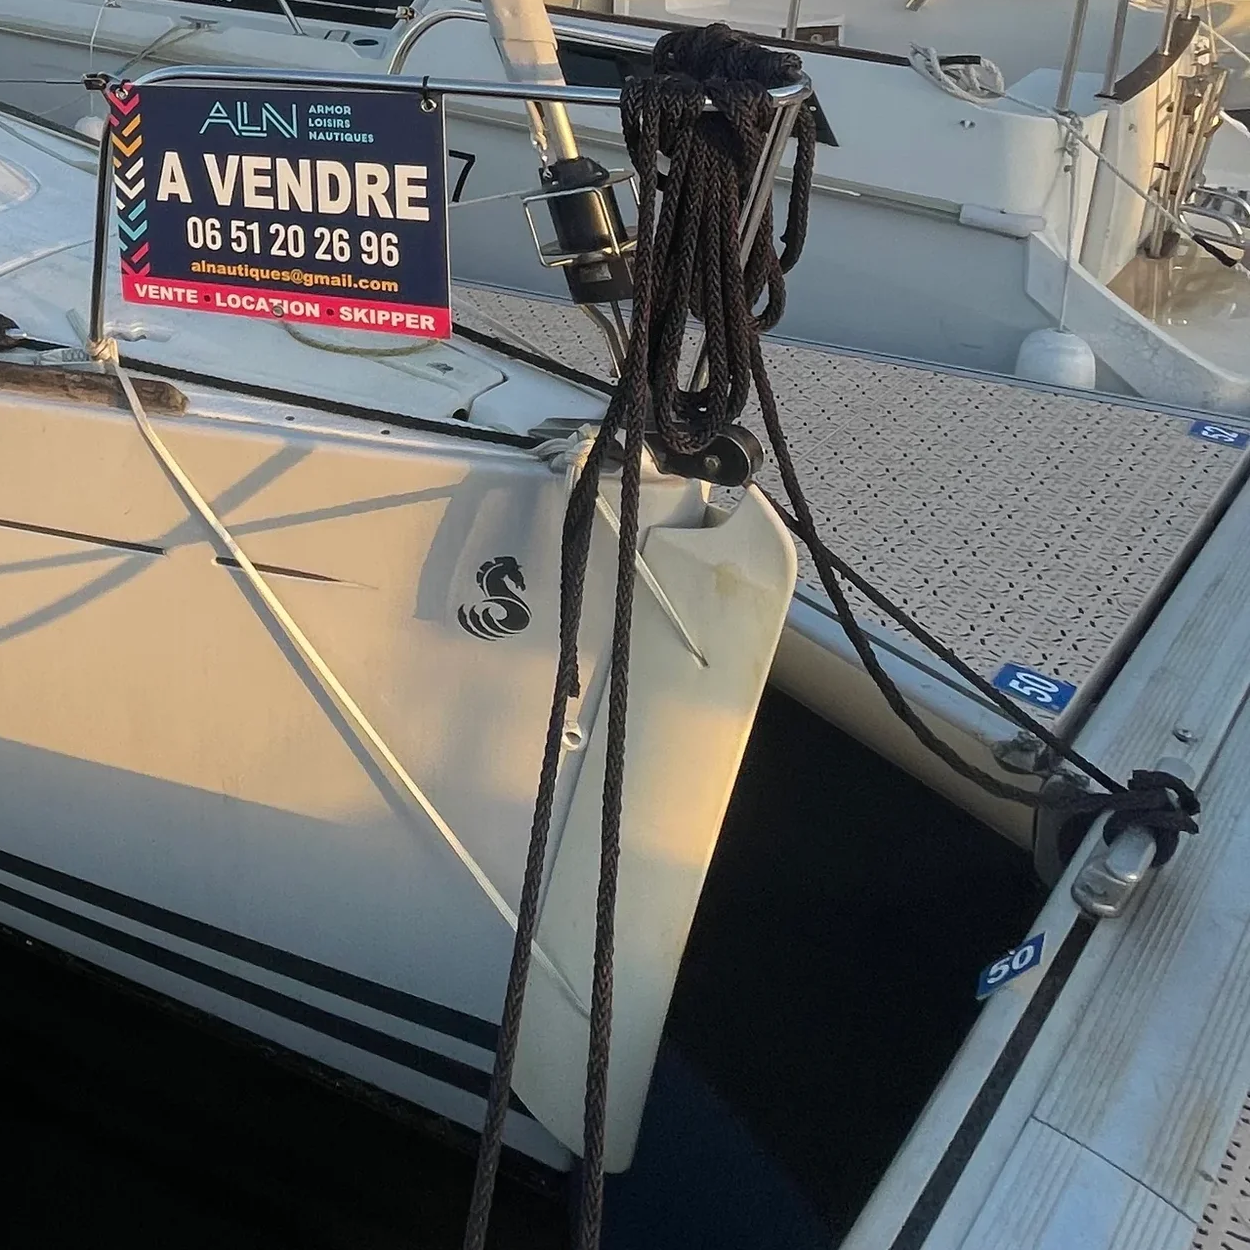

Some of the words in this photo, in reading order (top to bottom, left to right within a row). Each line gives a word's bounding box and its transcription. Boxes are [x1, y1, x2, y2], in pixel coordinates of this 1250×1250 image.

[199, 101, 298, 139] ALN
[308, 105, 352, 115] ARMOR
[308, 118, 351, 129] LOISIRS
[308, 131, 374, 143] NAUTIQUES
[156, 151, 192, 203] A
[203, 153, 430, 222] VENDRE
[186, 216, 222, 251] 06
[230, 220, 261, 254] 51
[269, 223, 305, 258] 20
[313, 226, 351, 263] 26
[360, 230, 400, 268] 96
[191, 260, 399, 292] alnautiques@gmail.com
[134, 283, 199, 304] VENTE
[215, 292, 321, 318] LOCATION
[339, 306, 436, 330] SKIPPER
[1202, 425, 1238, 442] 52
[1009, 671, 1060, 703] 50
[986, 945, 1035, 984] 50
